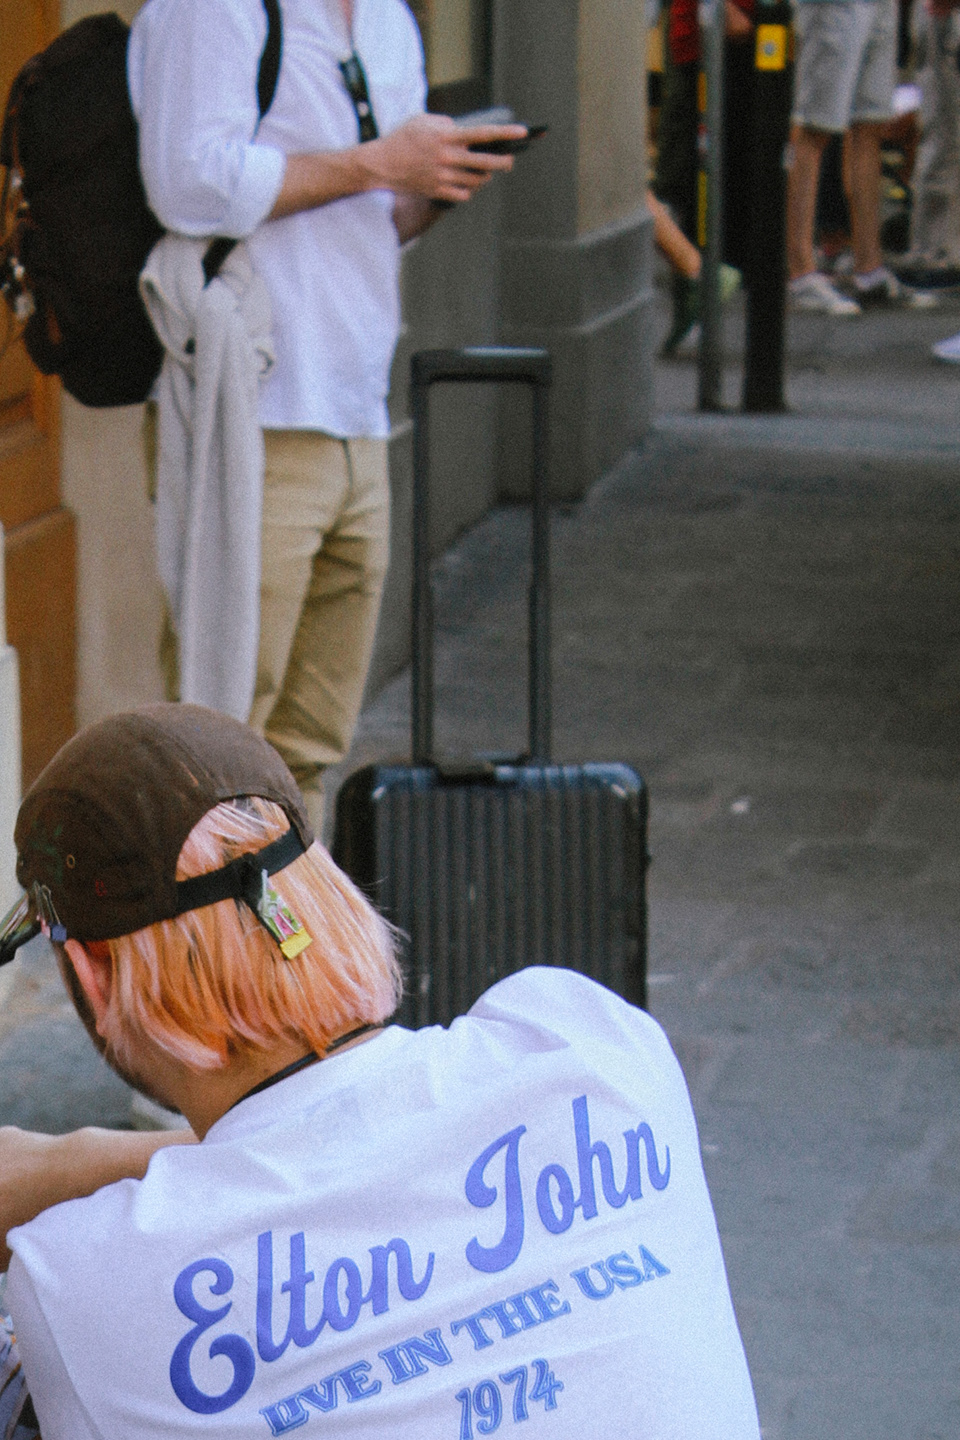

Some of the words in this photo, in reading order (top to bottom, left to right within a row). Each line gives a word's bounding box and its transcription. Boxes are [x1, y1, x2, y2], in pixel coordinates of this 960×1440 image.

[170, 1230, 434, 1414] Elton
[465, 1094, 671, 1273] John
[259, 1360, 382, 1437] LIVE
[378, 1328, 453, 1385] IN
[451, 1280, 572, 1351] THE
[569, 1244, 671, 1301] USA
